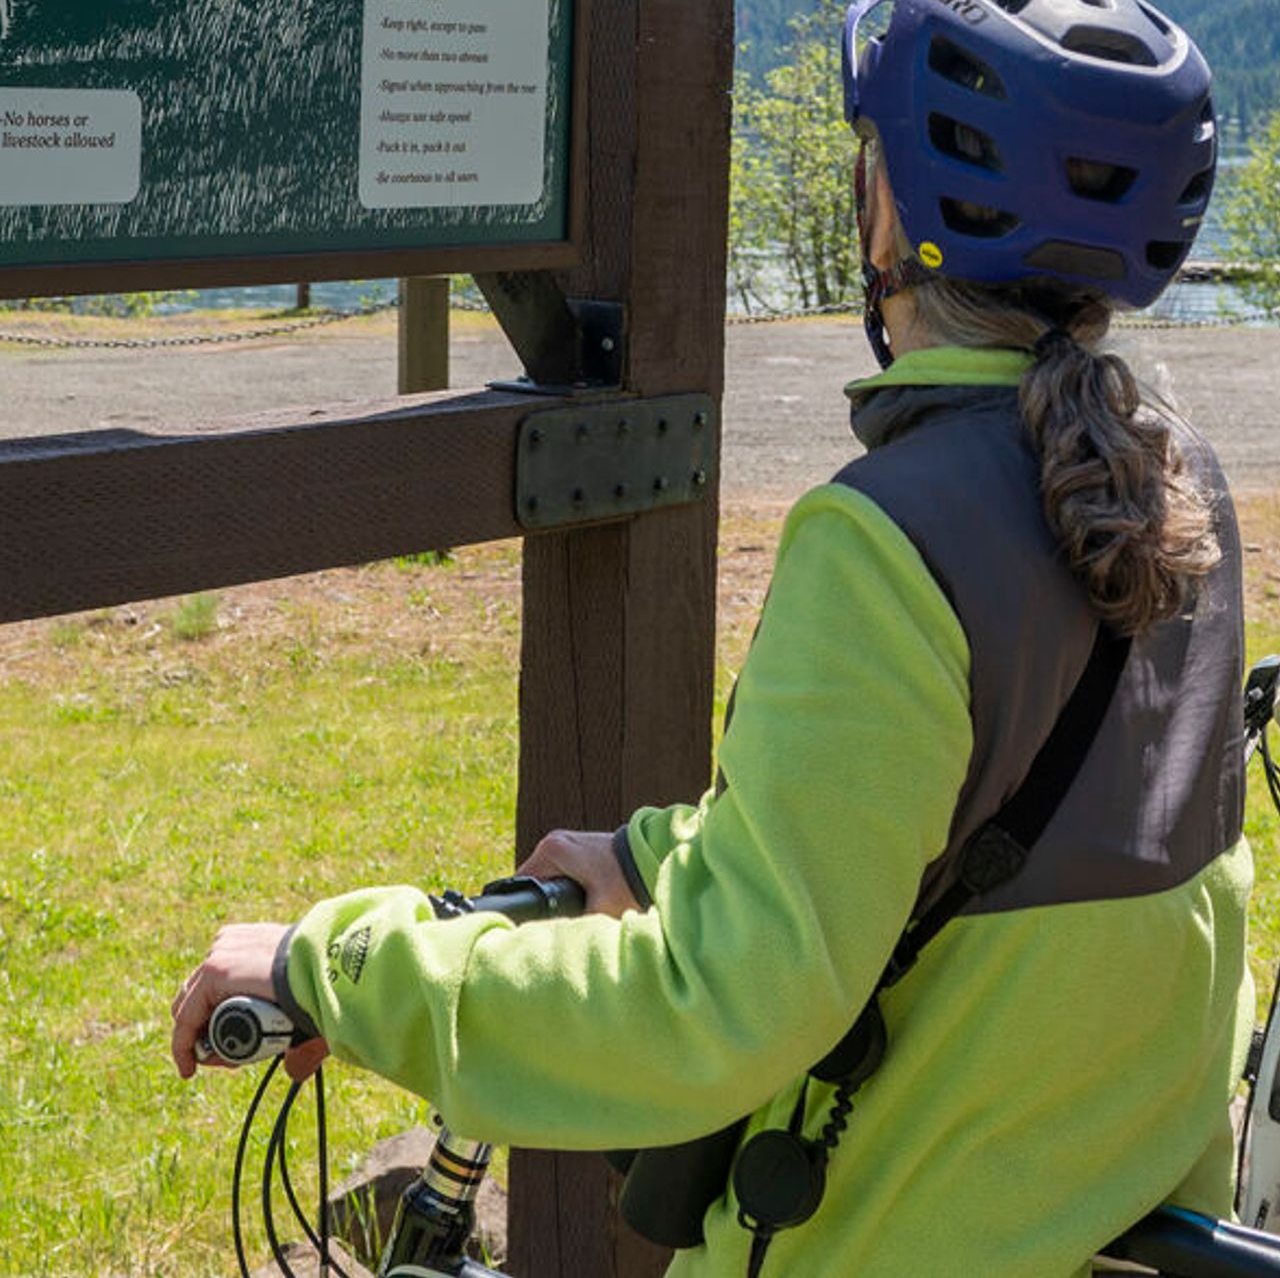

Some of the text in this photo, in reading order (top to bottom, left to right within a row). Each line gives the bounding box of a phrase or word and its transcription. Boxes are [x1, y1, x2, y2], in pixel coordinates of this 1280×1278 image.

[0, 111, 89, 127] -No horses or
[2, 132, 114, 146] livestock allowed
